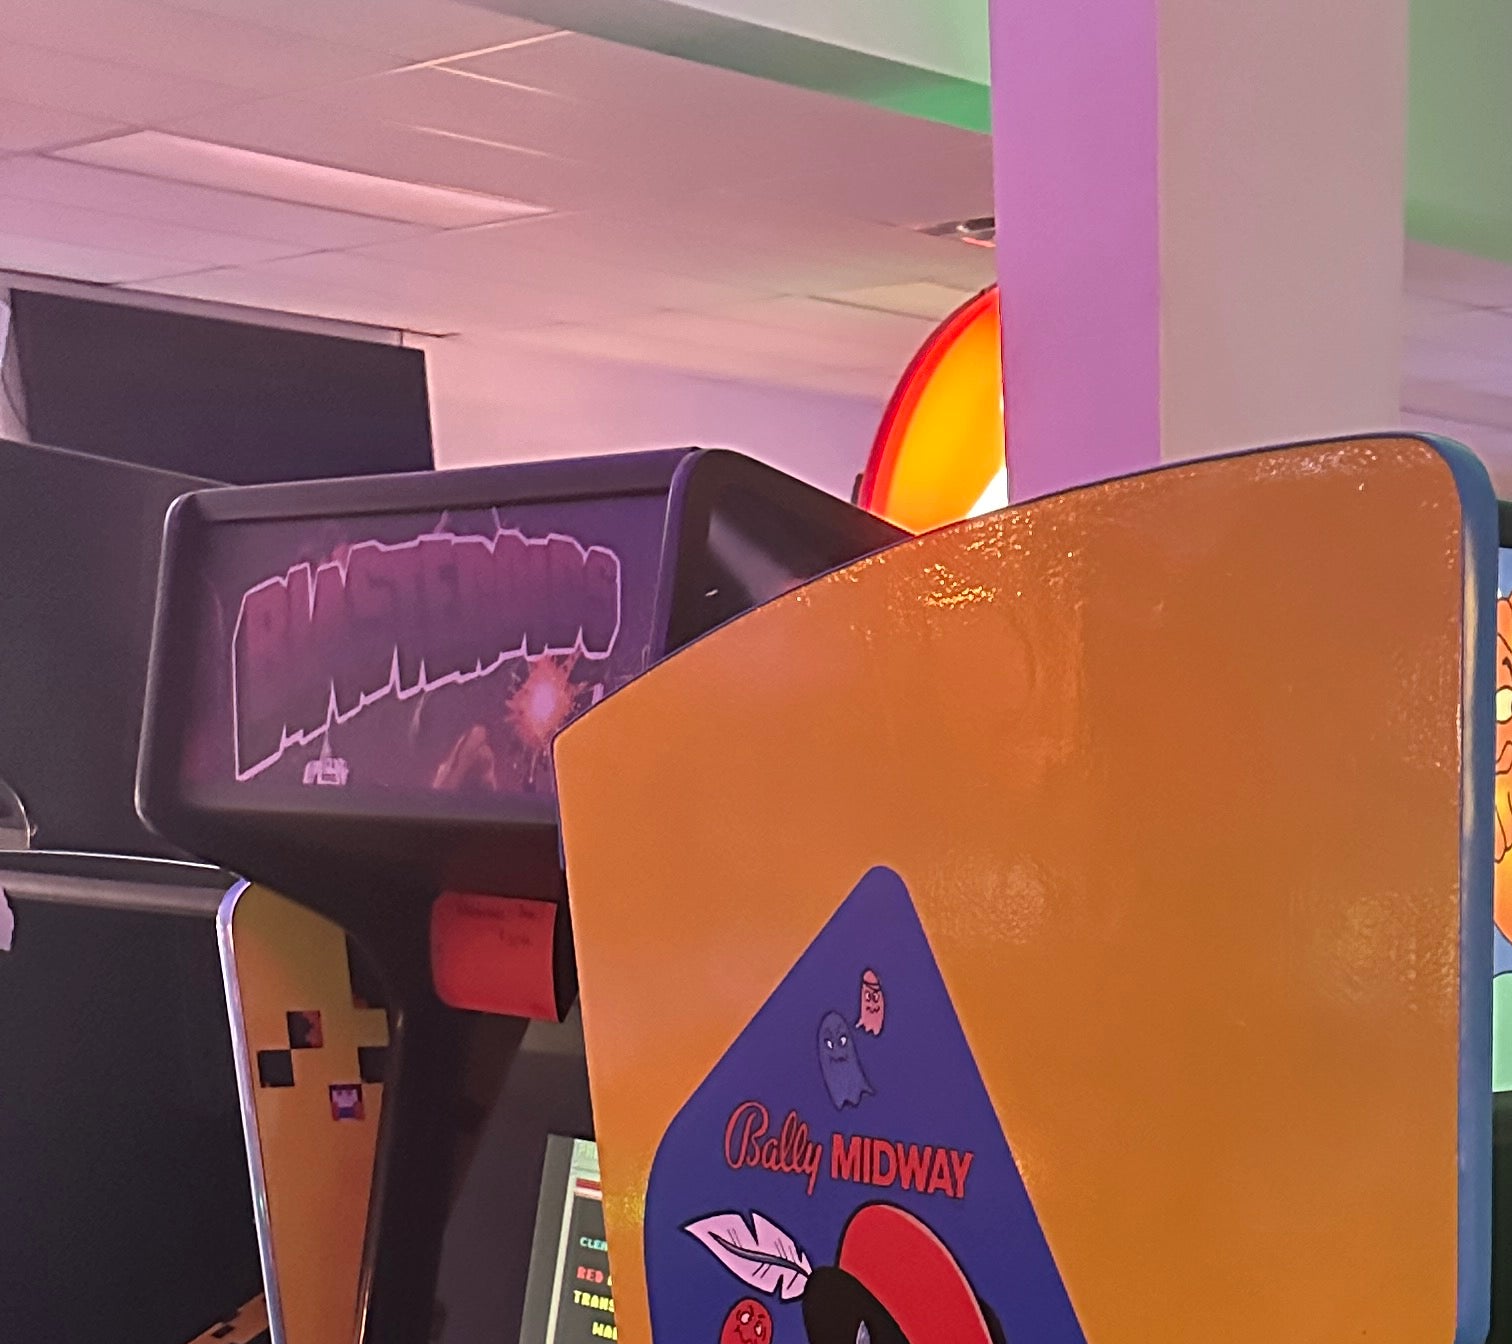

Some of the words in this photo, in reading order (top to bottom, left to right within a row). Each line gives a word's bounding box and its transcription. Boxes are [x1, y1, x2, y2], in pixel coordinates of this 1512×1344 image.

[724, 1100, 823, 1197] Bally
[831, 1133, 974, 1199] MIDWAY
[576, 1266, 604, 1283] RED
